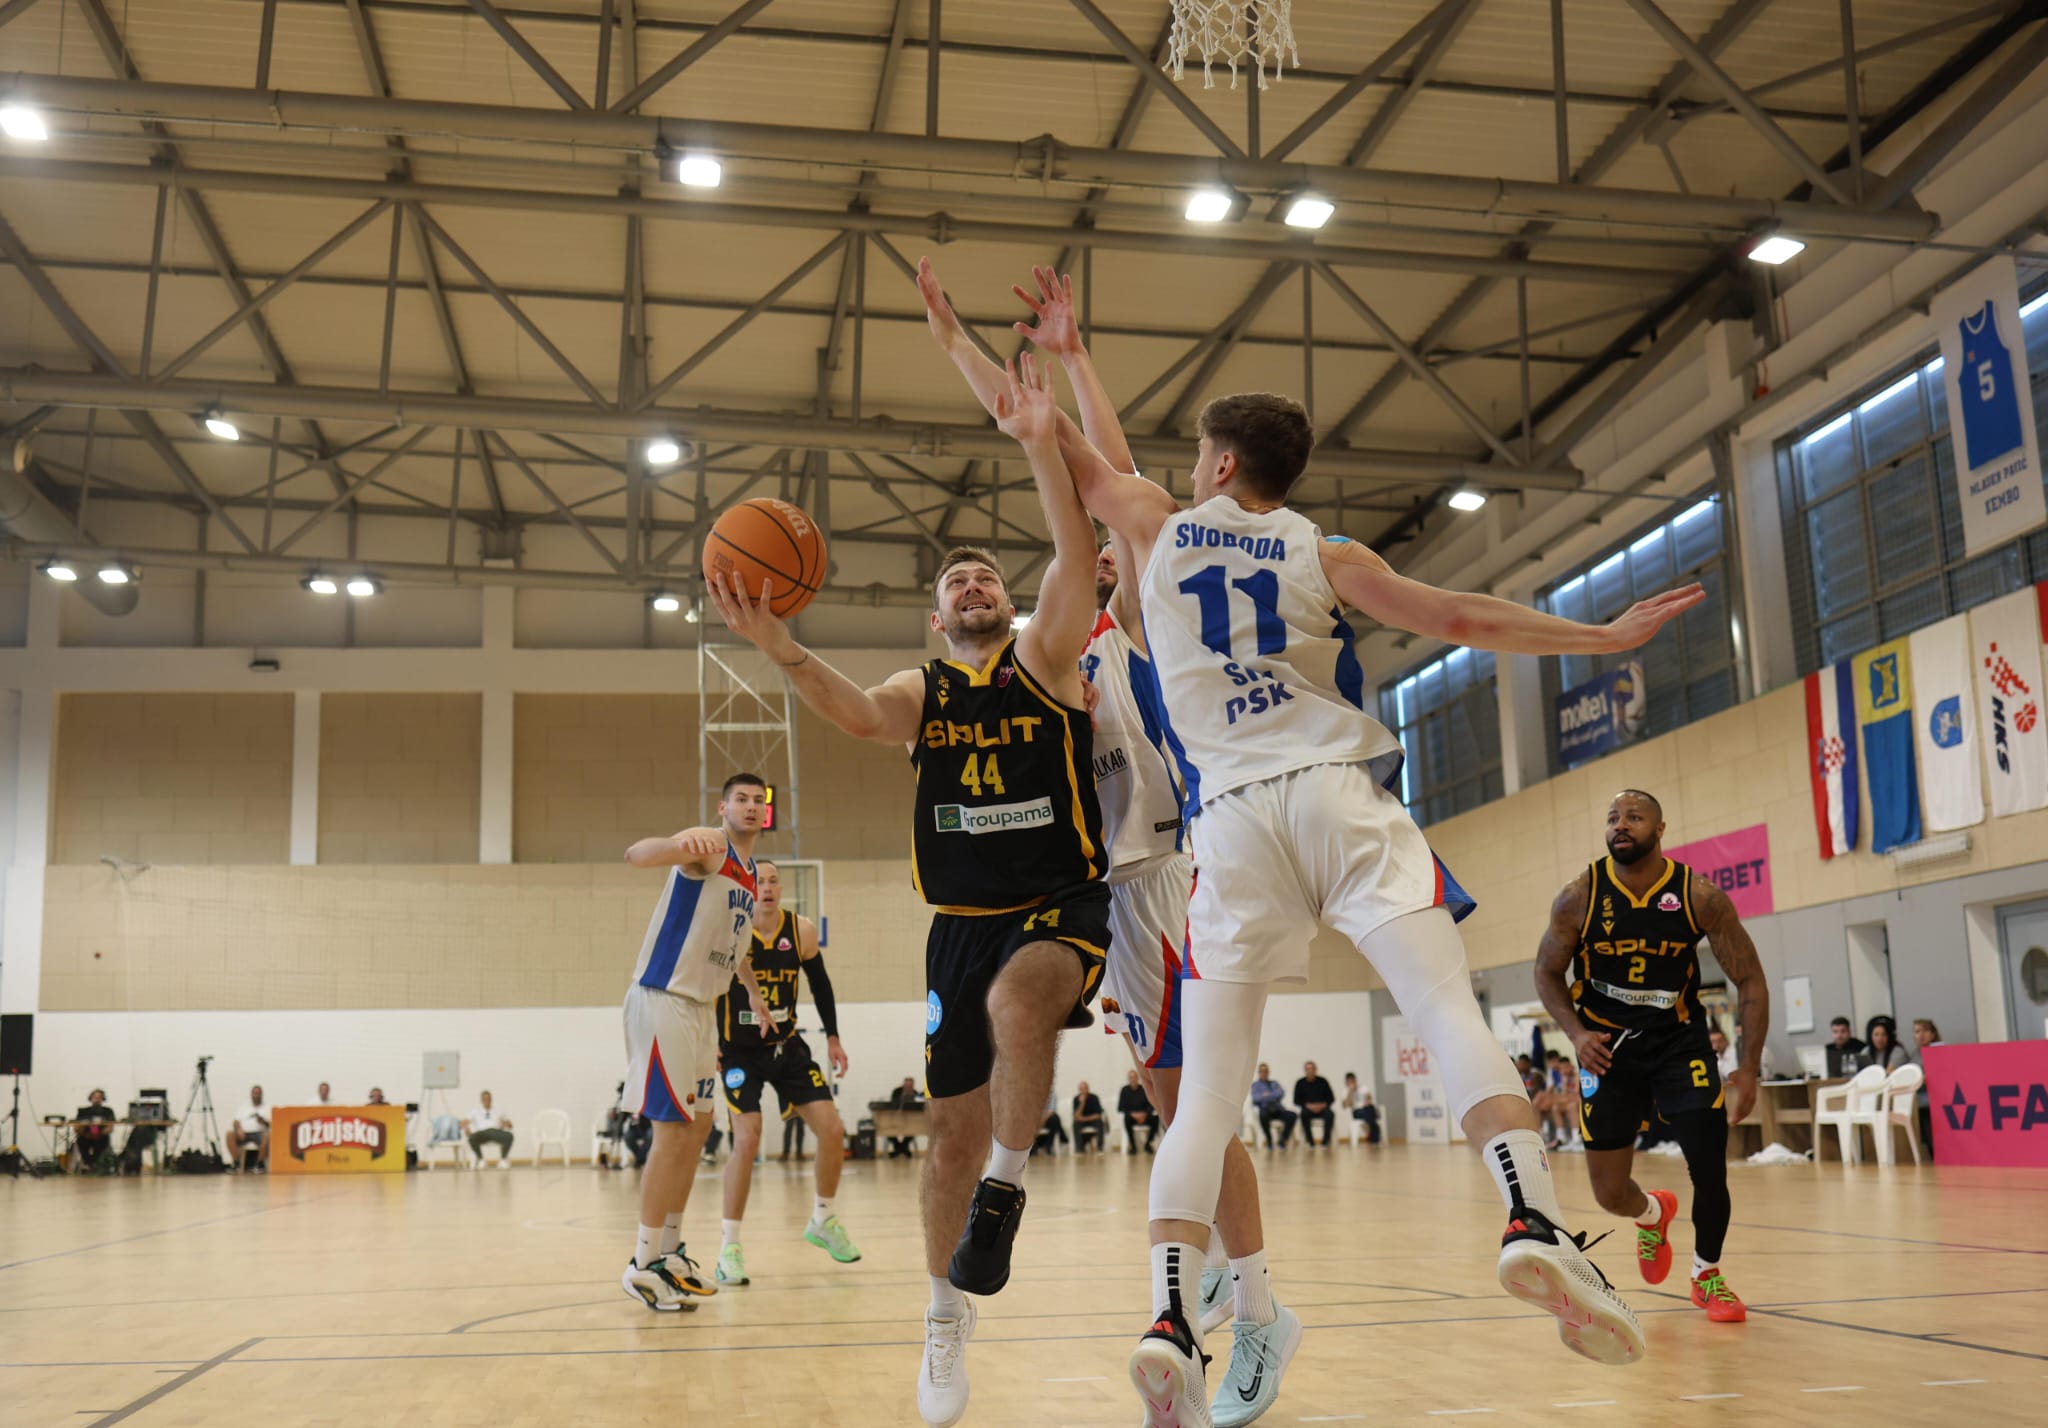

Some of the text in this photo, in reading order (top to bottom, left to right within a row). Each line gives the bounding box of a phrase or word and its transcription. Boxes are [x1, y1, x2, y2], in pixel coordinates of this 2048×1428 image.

[1978, 360, 1995, 402] 5
[1176, 523, 1285, 561] SVOBODA
[1178, 565, 1287, 659] 11
[1226, 683, 1295, 725] PSK
[925, 717, 1042, 748] SPLIT
[960, 753, 1006, 796] 44
[1593, 938, 1688, 957] SPLIT
[1628, 956, 1647, 984] 2
[696, 1078, 715, 1099] 12
[1689, 1059, 1709, 1088] 2
[297, 1117, 380, 1150] Ožujsko
